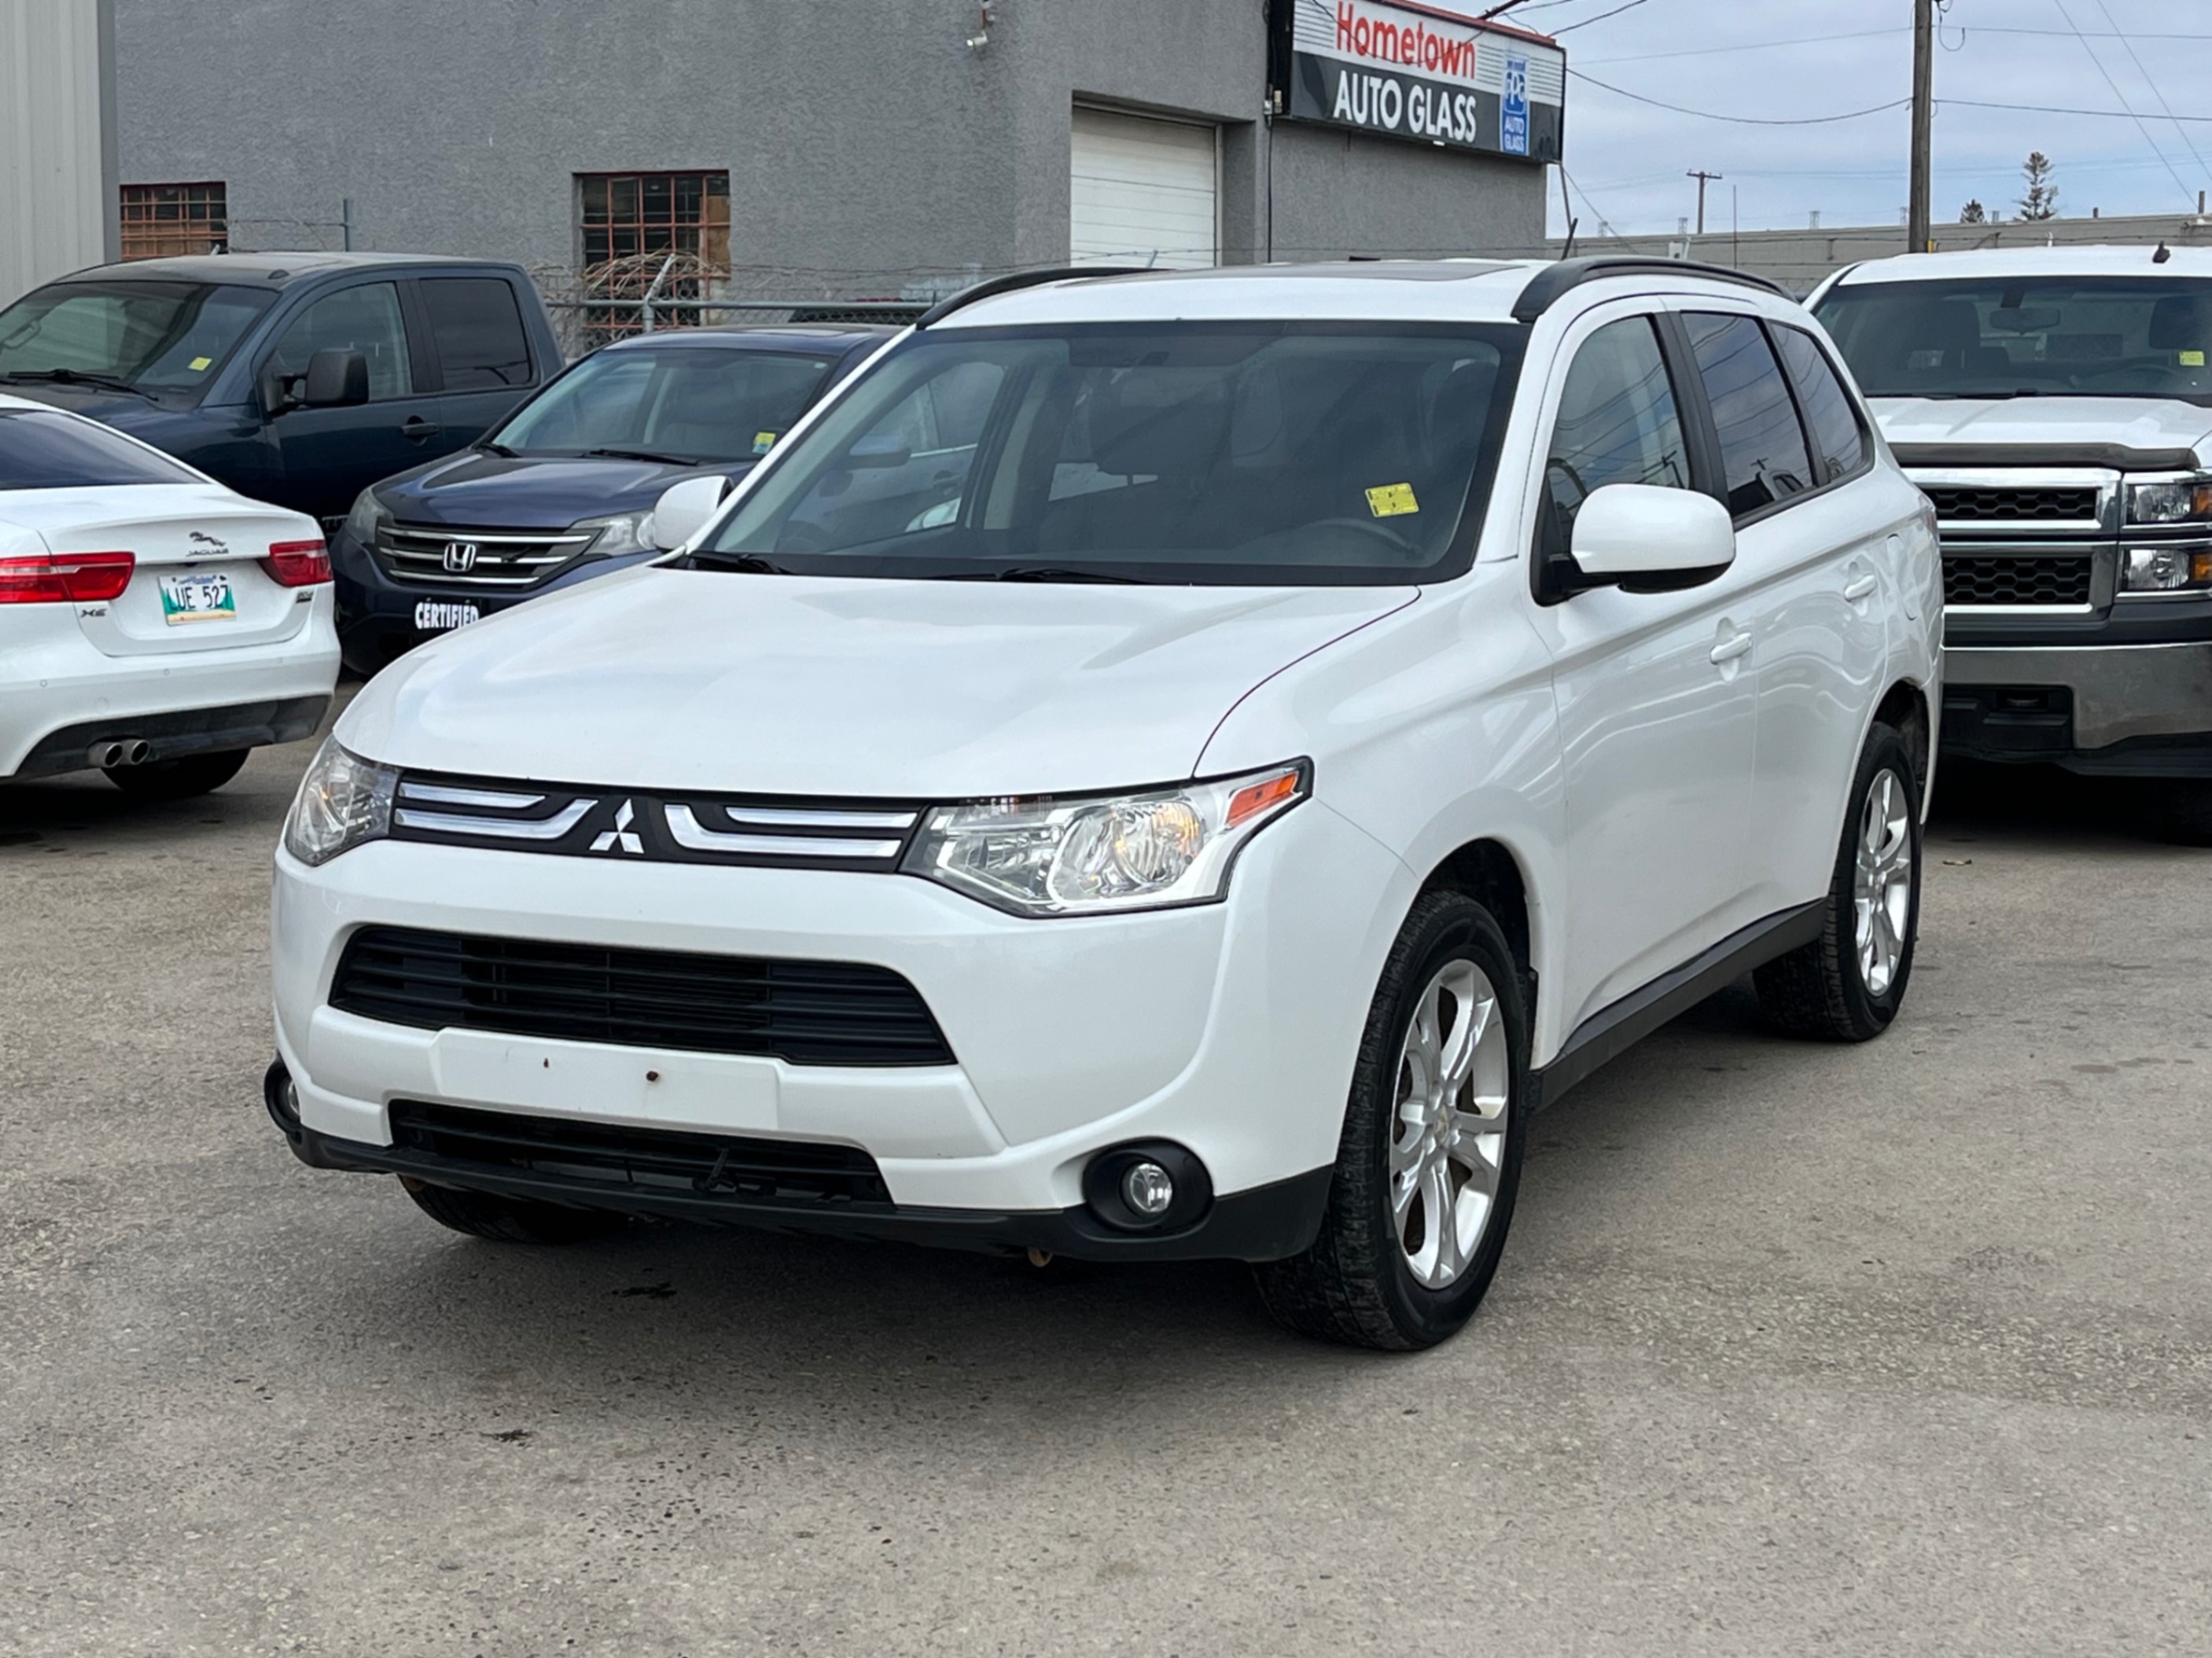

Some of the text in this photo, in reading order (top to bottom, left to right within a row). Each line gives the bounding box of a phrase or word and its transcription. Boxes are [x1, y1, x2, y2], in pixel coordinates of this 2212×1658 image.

[1337, 1, 1475, 79] Hometown
[1334, 70, 1477, 143] AUTO GLASS
[202, 584, 229, 608] 527
[415, 602, 479, 629] CERTIFIED
